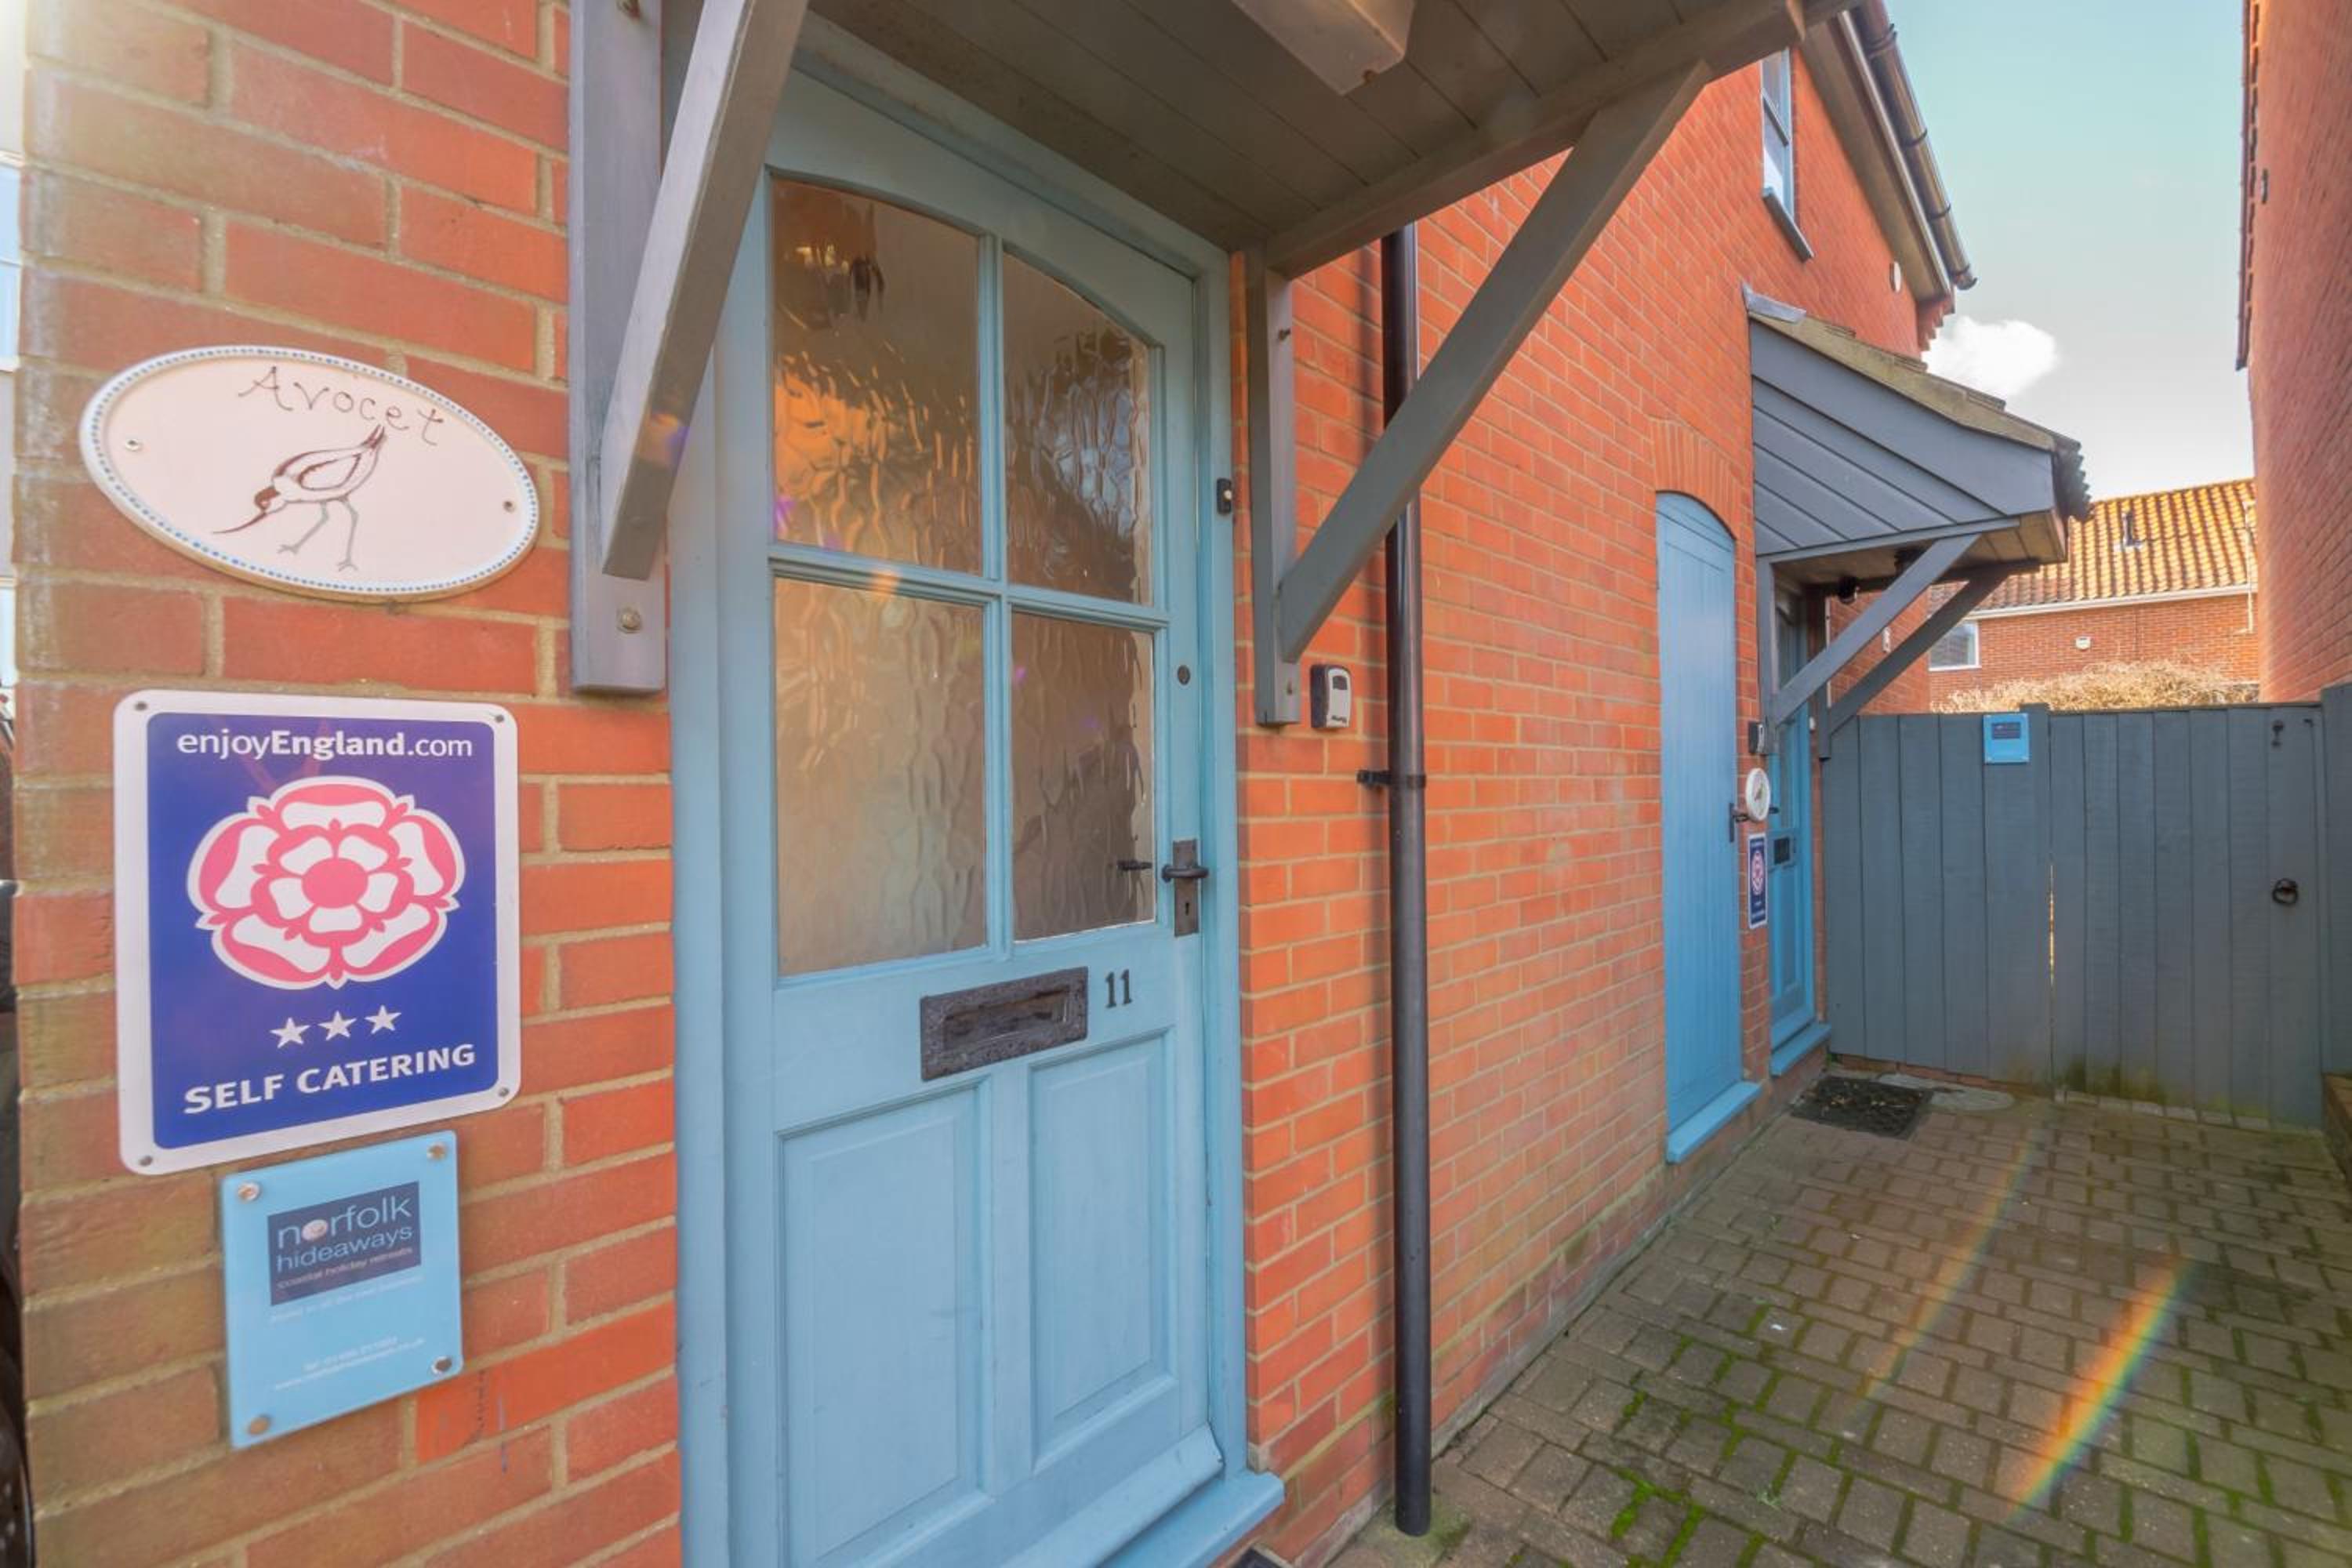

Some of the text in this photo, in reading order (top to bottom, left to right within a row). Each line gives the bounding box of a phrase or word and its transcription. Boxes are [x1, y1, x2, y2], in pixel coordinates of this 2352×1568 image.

[238, 365, 445, 446] Avocet
[176, 728, 473, 760] enjoyEngland.com
[1105, 969, 1133, 1008] 11
[183, 1044, 476, 1114] SELF CATERING
[278, 1195, 413, 1249] norfolk
[276, 1226, 413, 1273] hideaways
